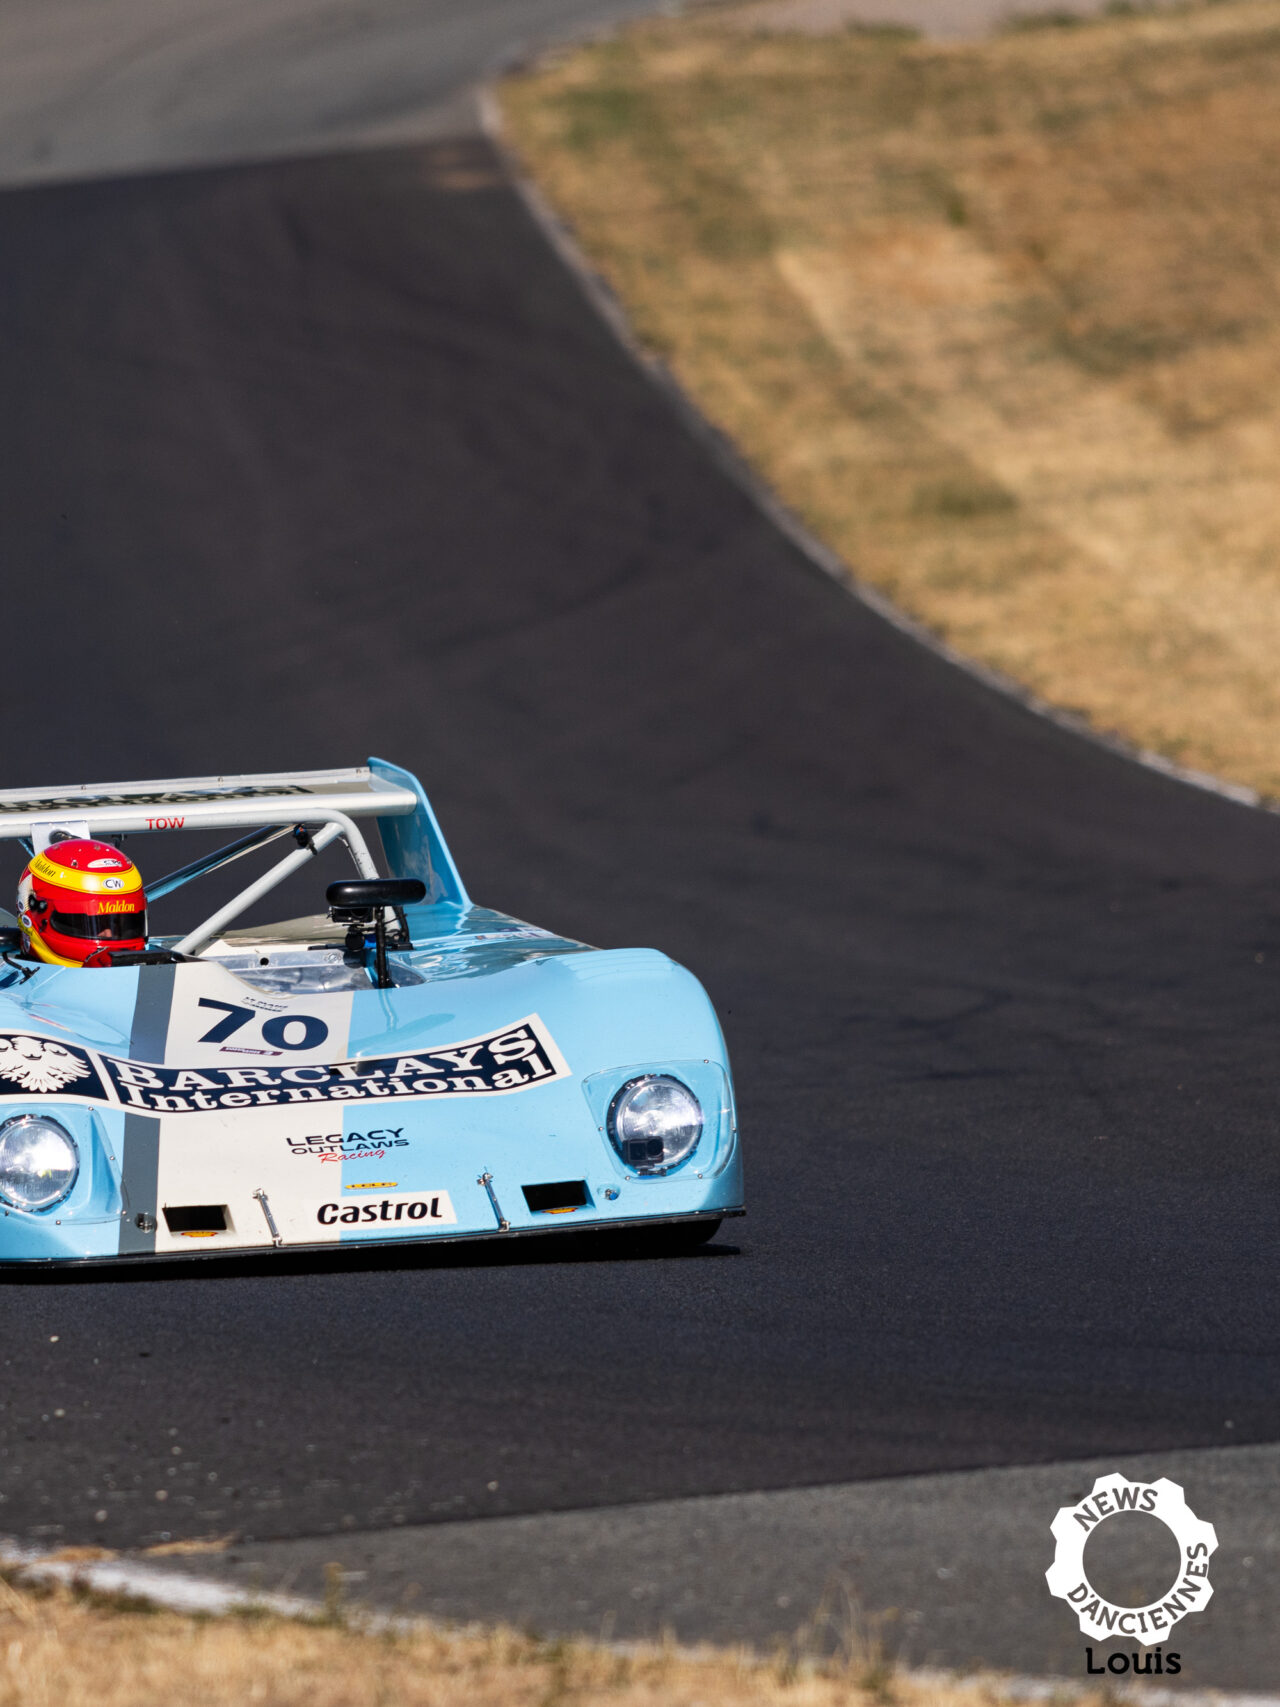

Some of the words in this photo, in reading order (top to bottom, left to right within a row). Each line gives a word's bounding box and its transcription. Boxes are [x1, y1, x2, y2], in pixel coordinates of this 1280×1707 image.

[144, 816, 185, 831] TOW
[104, 880, 122, 889] CW
[96, 899, 136, 914] Maldon
[196, 997, 329, 1051] 70
[116, 1028, 539, 1091] BARCLAYS
[119, 1053, 554, 1112] International
[285, 1127, 405, 1147] LEGACY
[291, 1138, 410, 1155] OUTLAWS
[317, 1149, 386, 1164] Racing
[316, 1197, 443, 1225] Castrol
